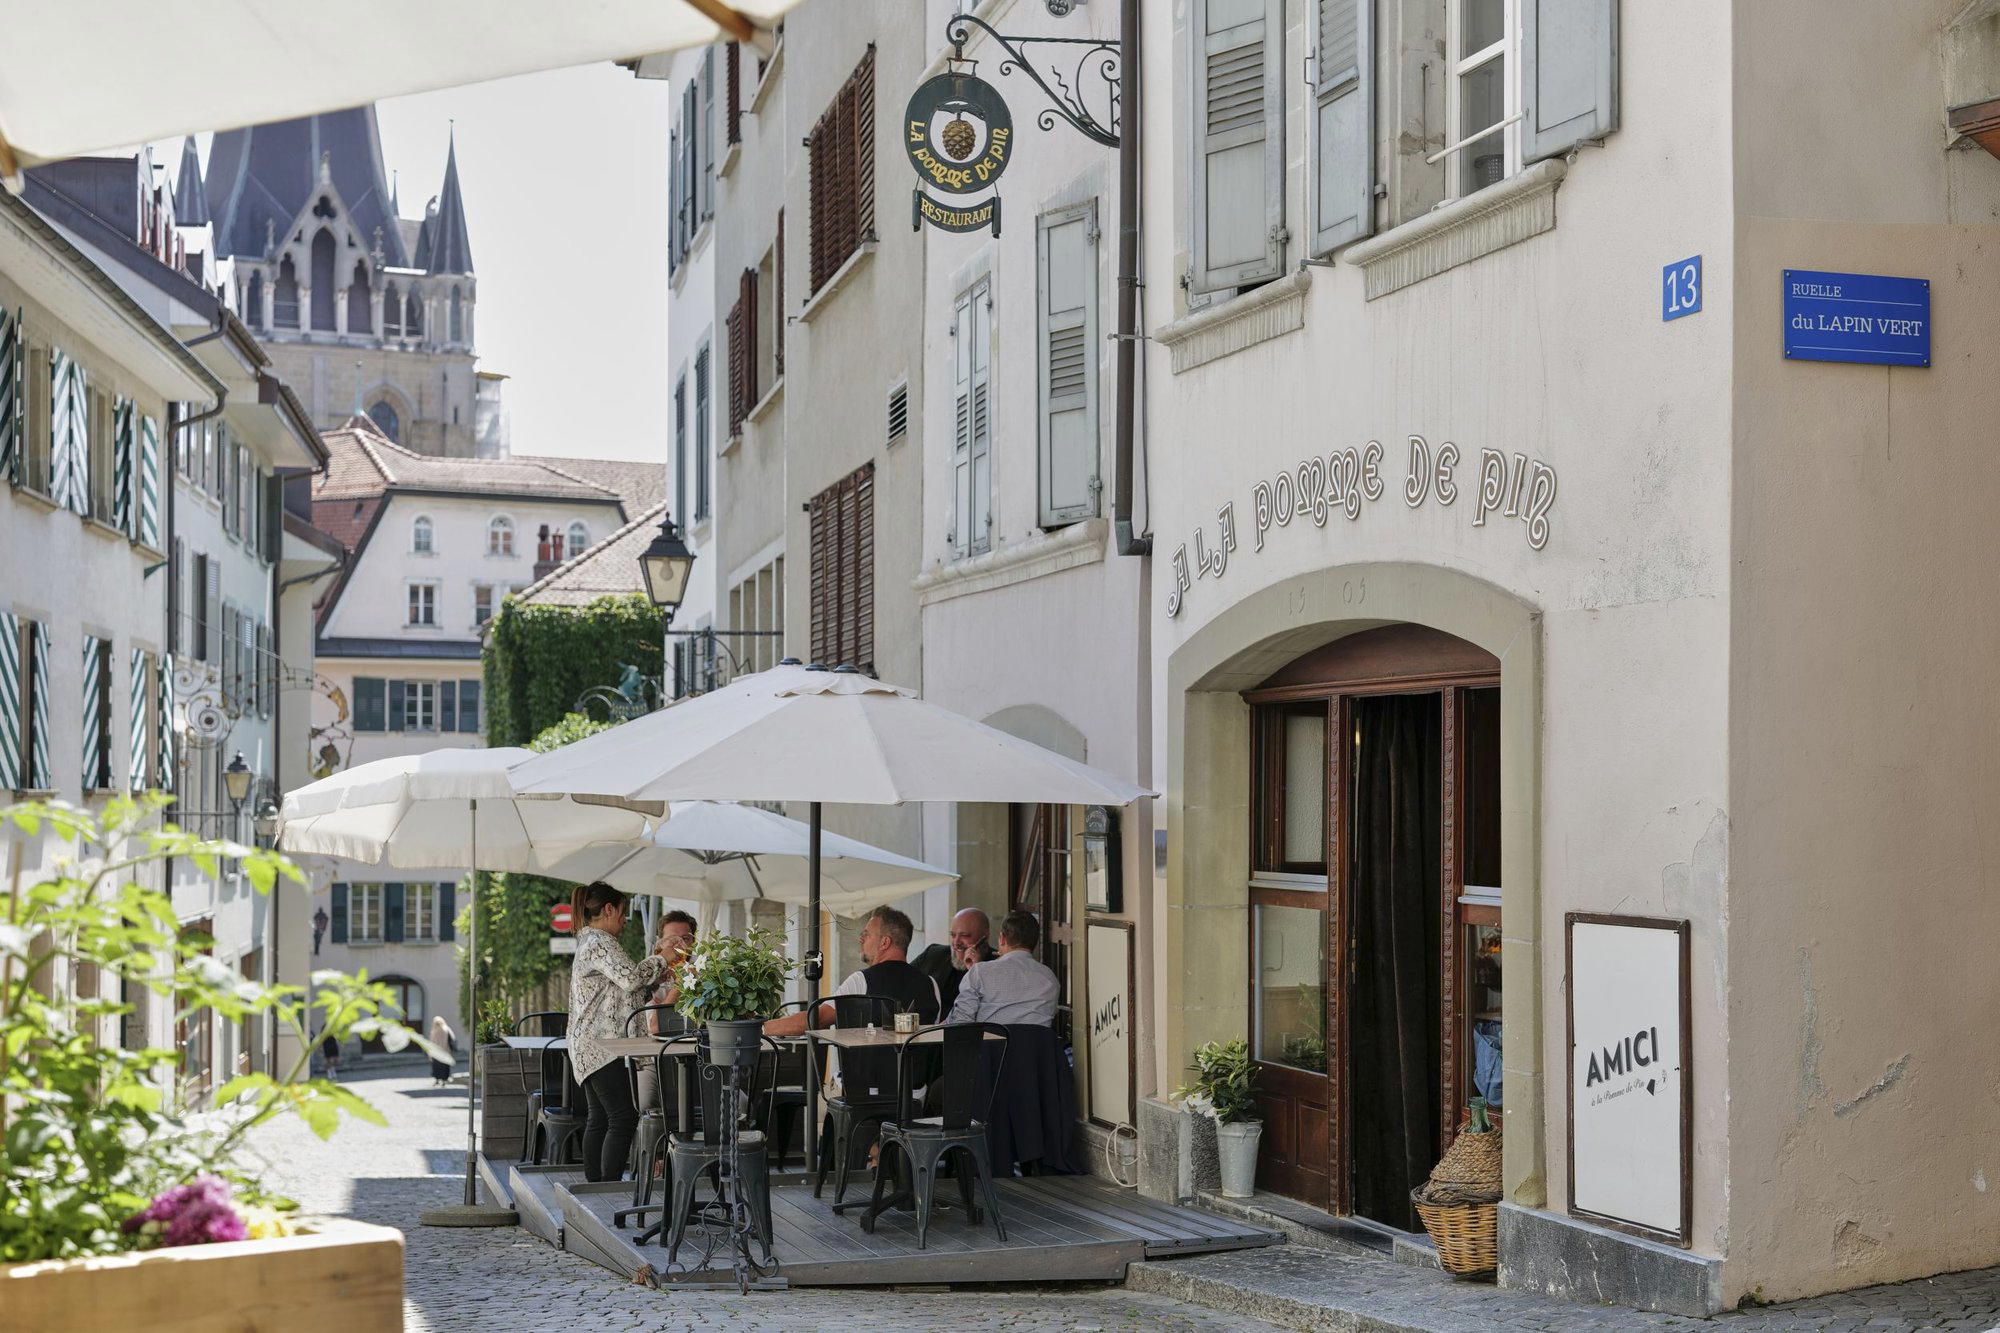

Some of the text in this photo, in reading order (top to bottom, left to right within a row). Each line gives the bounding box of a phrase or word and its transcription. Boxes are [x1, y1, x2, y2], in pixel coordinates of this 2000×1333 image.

[910, 120, 1009, 189] LA POMME DE PIN
[920, 197, 994, 226] RESTAURANT
[1667, 265, 1697, 313] 13
[1792, 283, 1842, 298] RUELLE
[1792, 314, 1923, 337] du LAPIN VERT
[1194, 501, 1237, 580] LA
[1252, 439, 1384, 552] POMME
[1403, 434, 1460, 508] DE
[1472, 447, 1558, 551] PIN
[1094, 994, 1121, 1036] AMICI
[1586, 1026, 1658, 1087] AMICI
